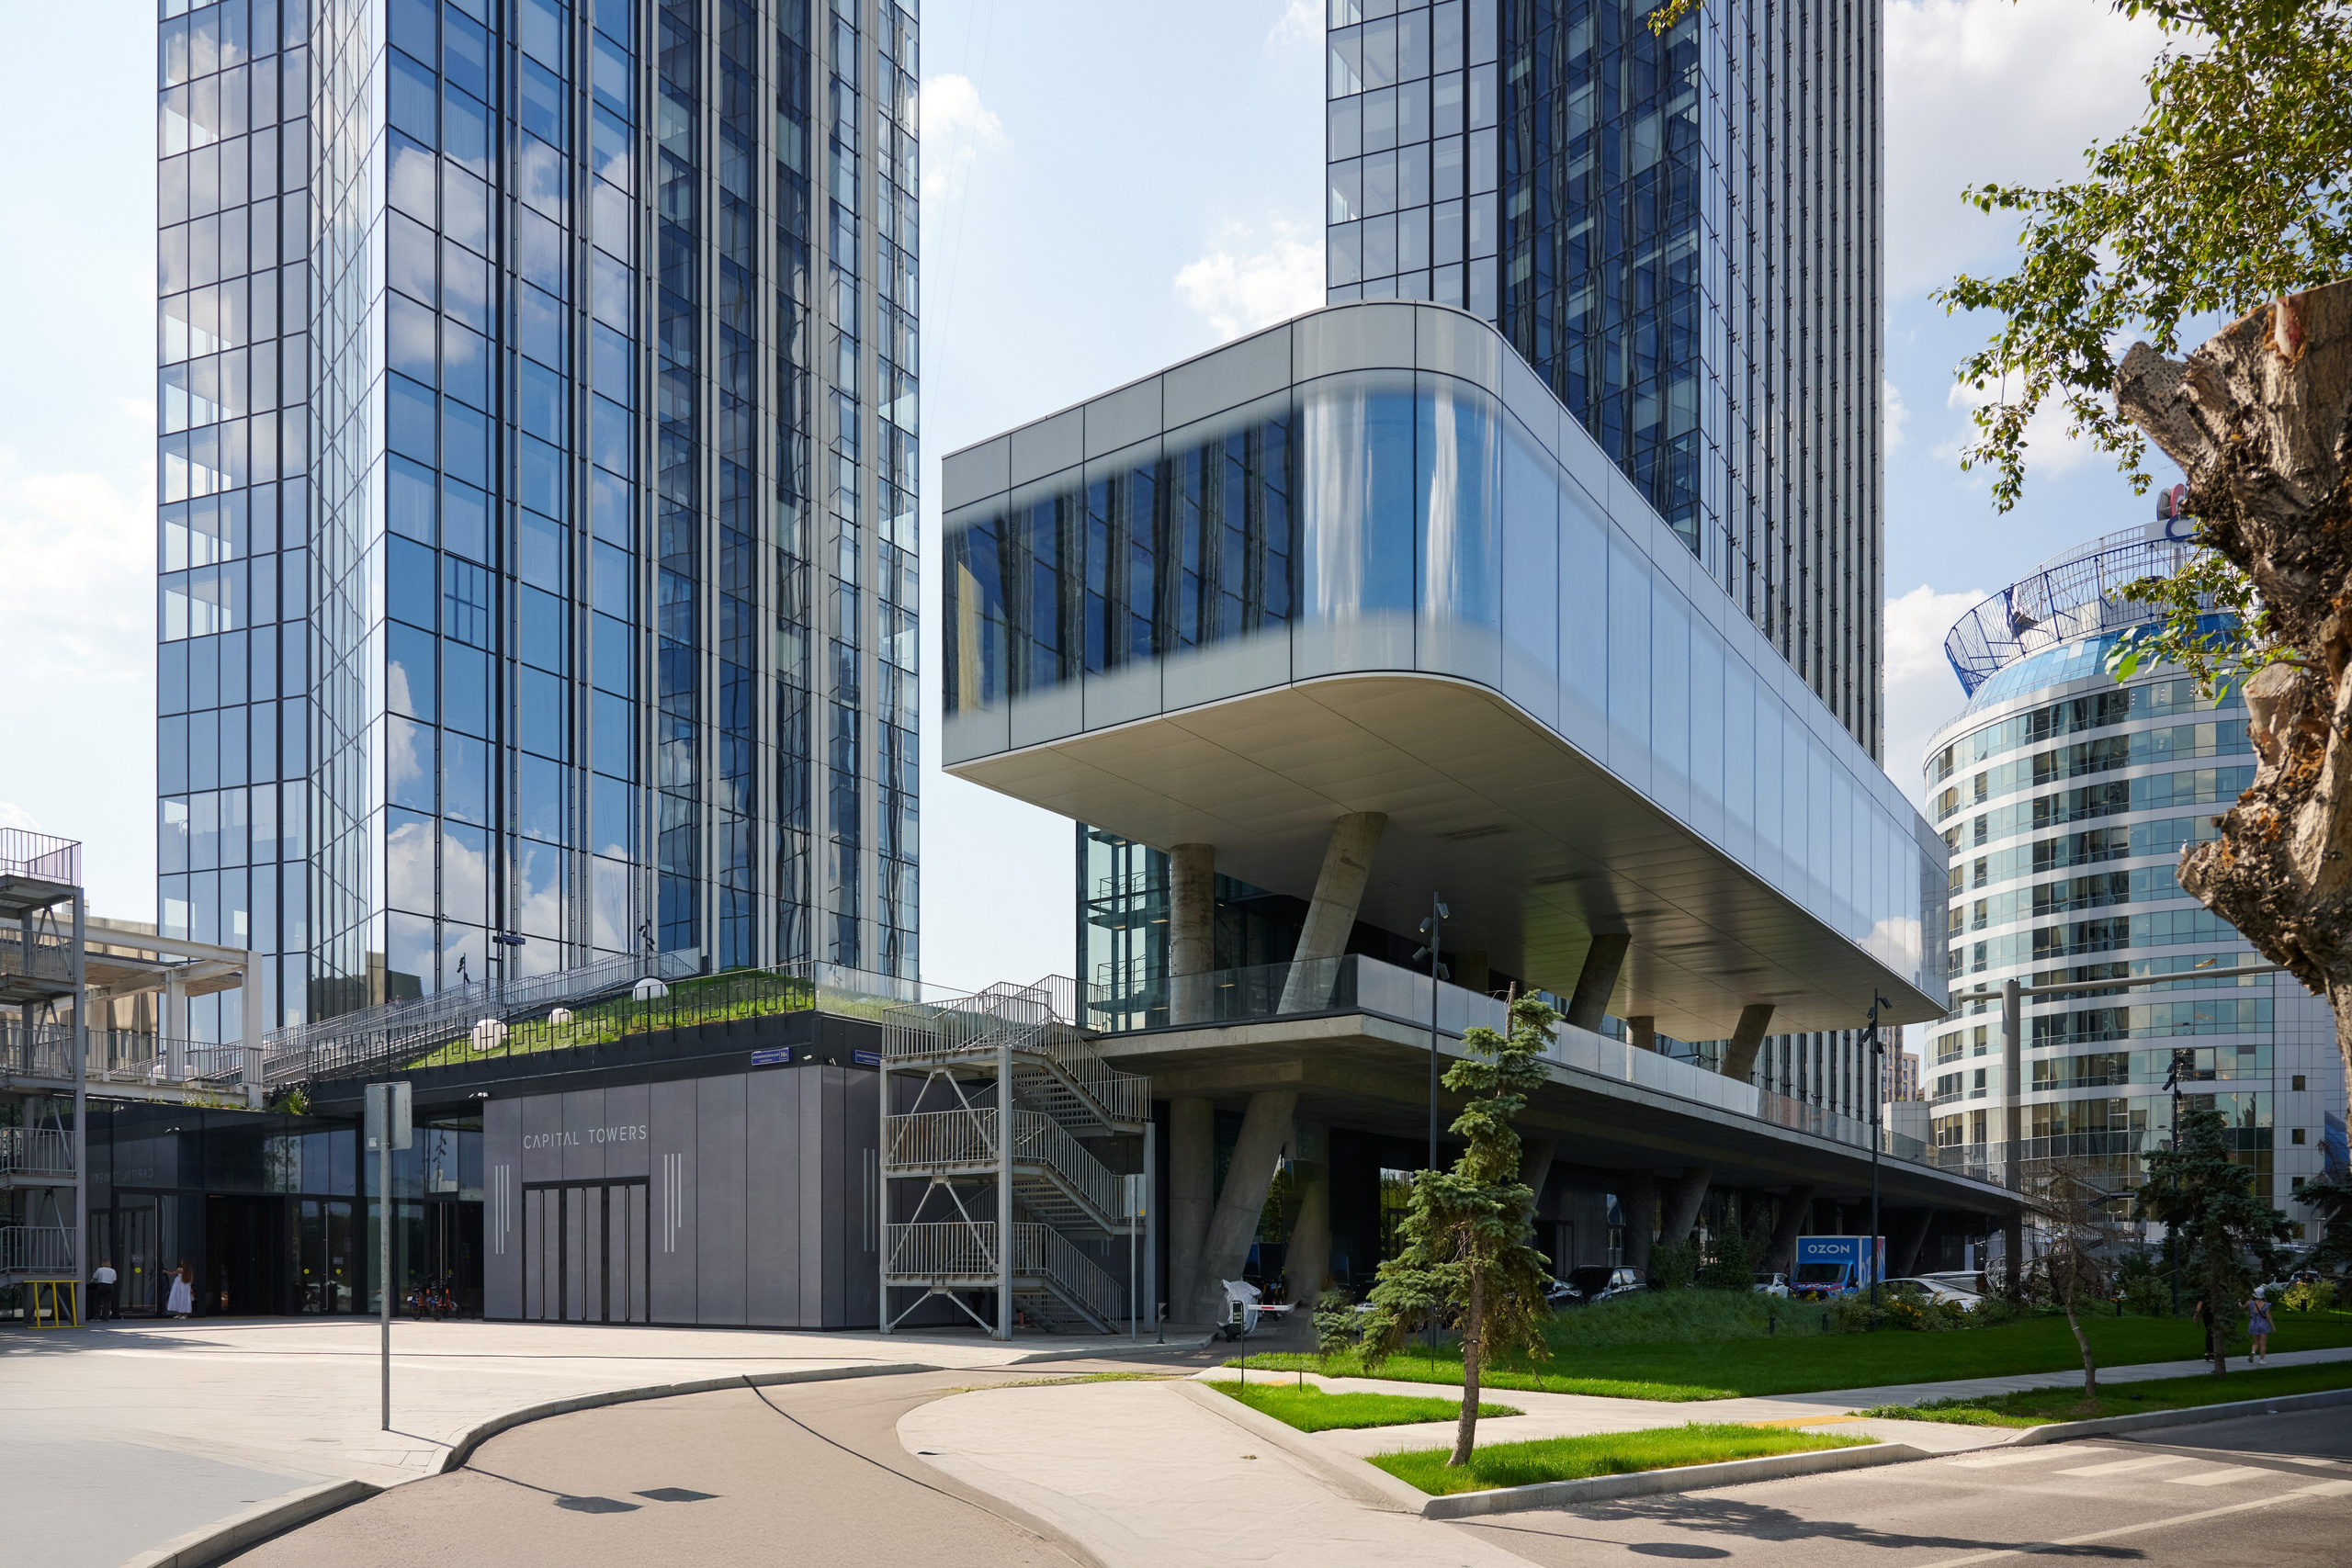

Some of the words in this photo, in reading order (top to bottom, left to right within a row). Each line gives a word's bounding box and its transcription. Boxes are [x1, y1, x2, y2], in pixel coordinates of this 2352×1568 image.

[523, 1132, 580, 1149] CAPITAL
[588, 1124, 647, 1145] TOWERS
[1807, 1244, 1850, 1254] OZON
